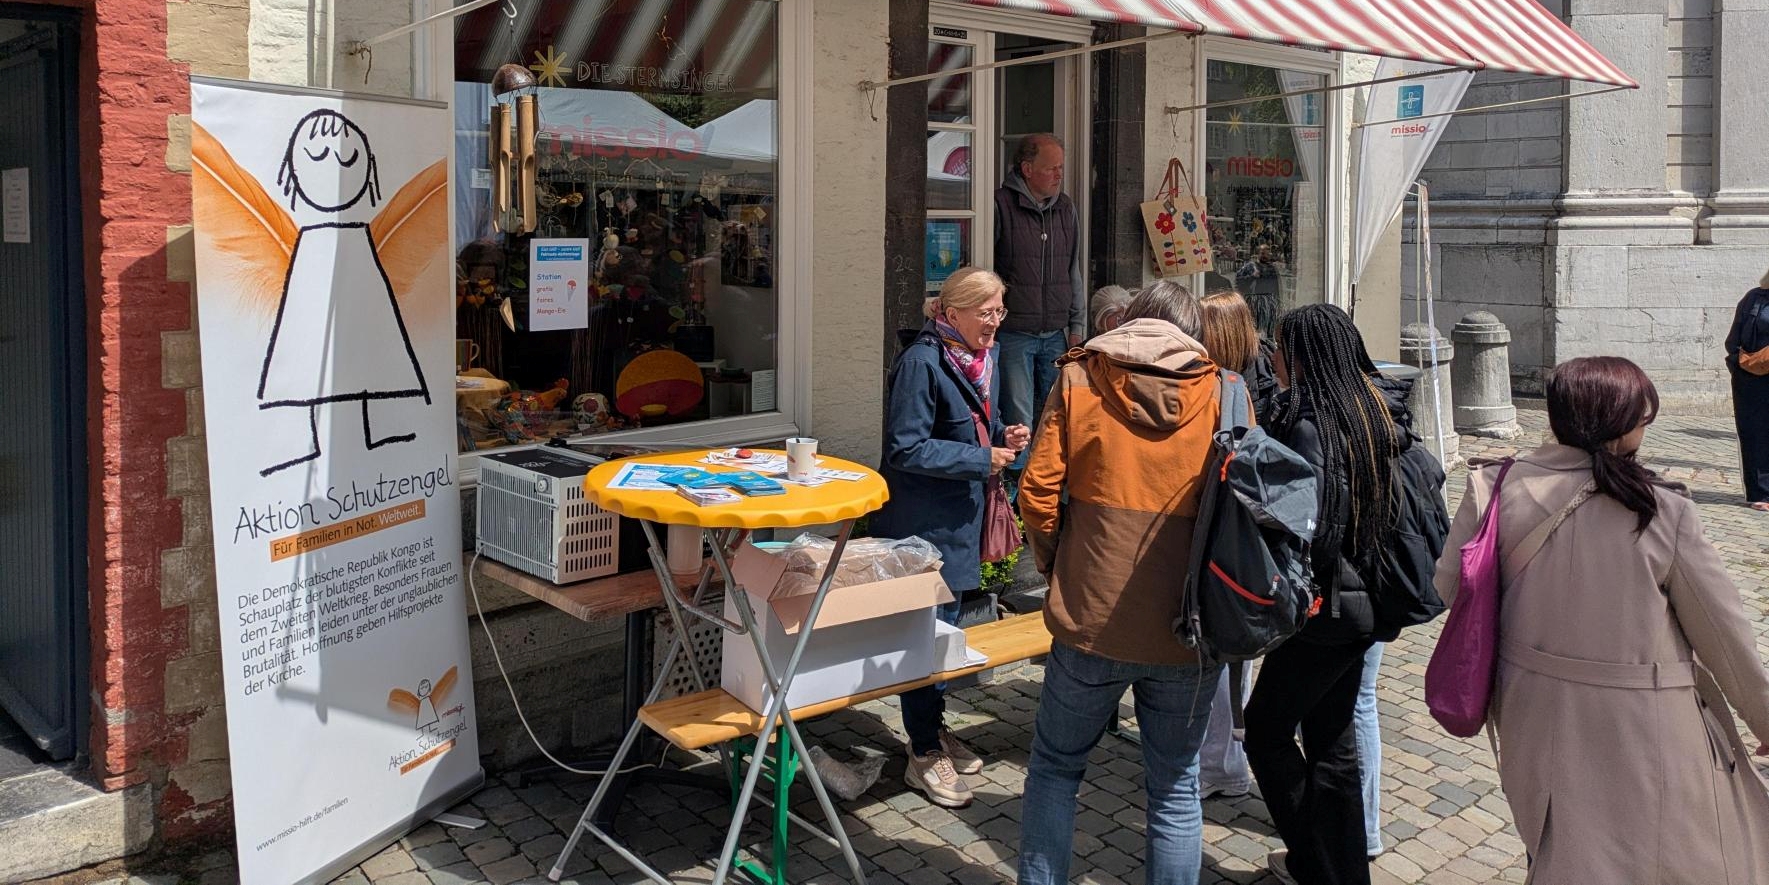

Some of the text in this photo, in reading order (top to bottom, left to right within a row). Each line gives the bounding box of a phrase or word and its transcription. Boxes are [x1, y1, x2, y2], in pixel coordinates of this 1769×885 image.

[577, 60, 736, 93] DIE STERNSINGER
[541, 115, 701, 161] missio
[1391, 124, 1426, 134] missio
[1227, 148, 1294, 177] missio
[233, 454, 453, 544] Aktion Schutzengel
[273, 504, 422, 556] Für Familien in Not. Weltweit.
[238, 535, 434, 609] Die Demokratische Republik Kongo ist
[239, 549, 436, 627] Schauplatz der blutigsten Konflikte seit
[240, 561, 452, 644] dem Zweiten Weltkrieg. Besonders Frauen
[242, 573, 458, 662] und Familien leiden unter der unglaublichen
[243, 592, 444, 679] Brutalität. Hoffnung geben Hilfsprojekte
[244, 663, 306, 696] der Kirche.
[389, 749, 417, 771] Aktion
[418, 716, 467, 754] Schutzengel
